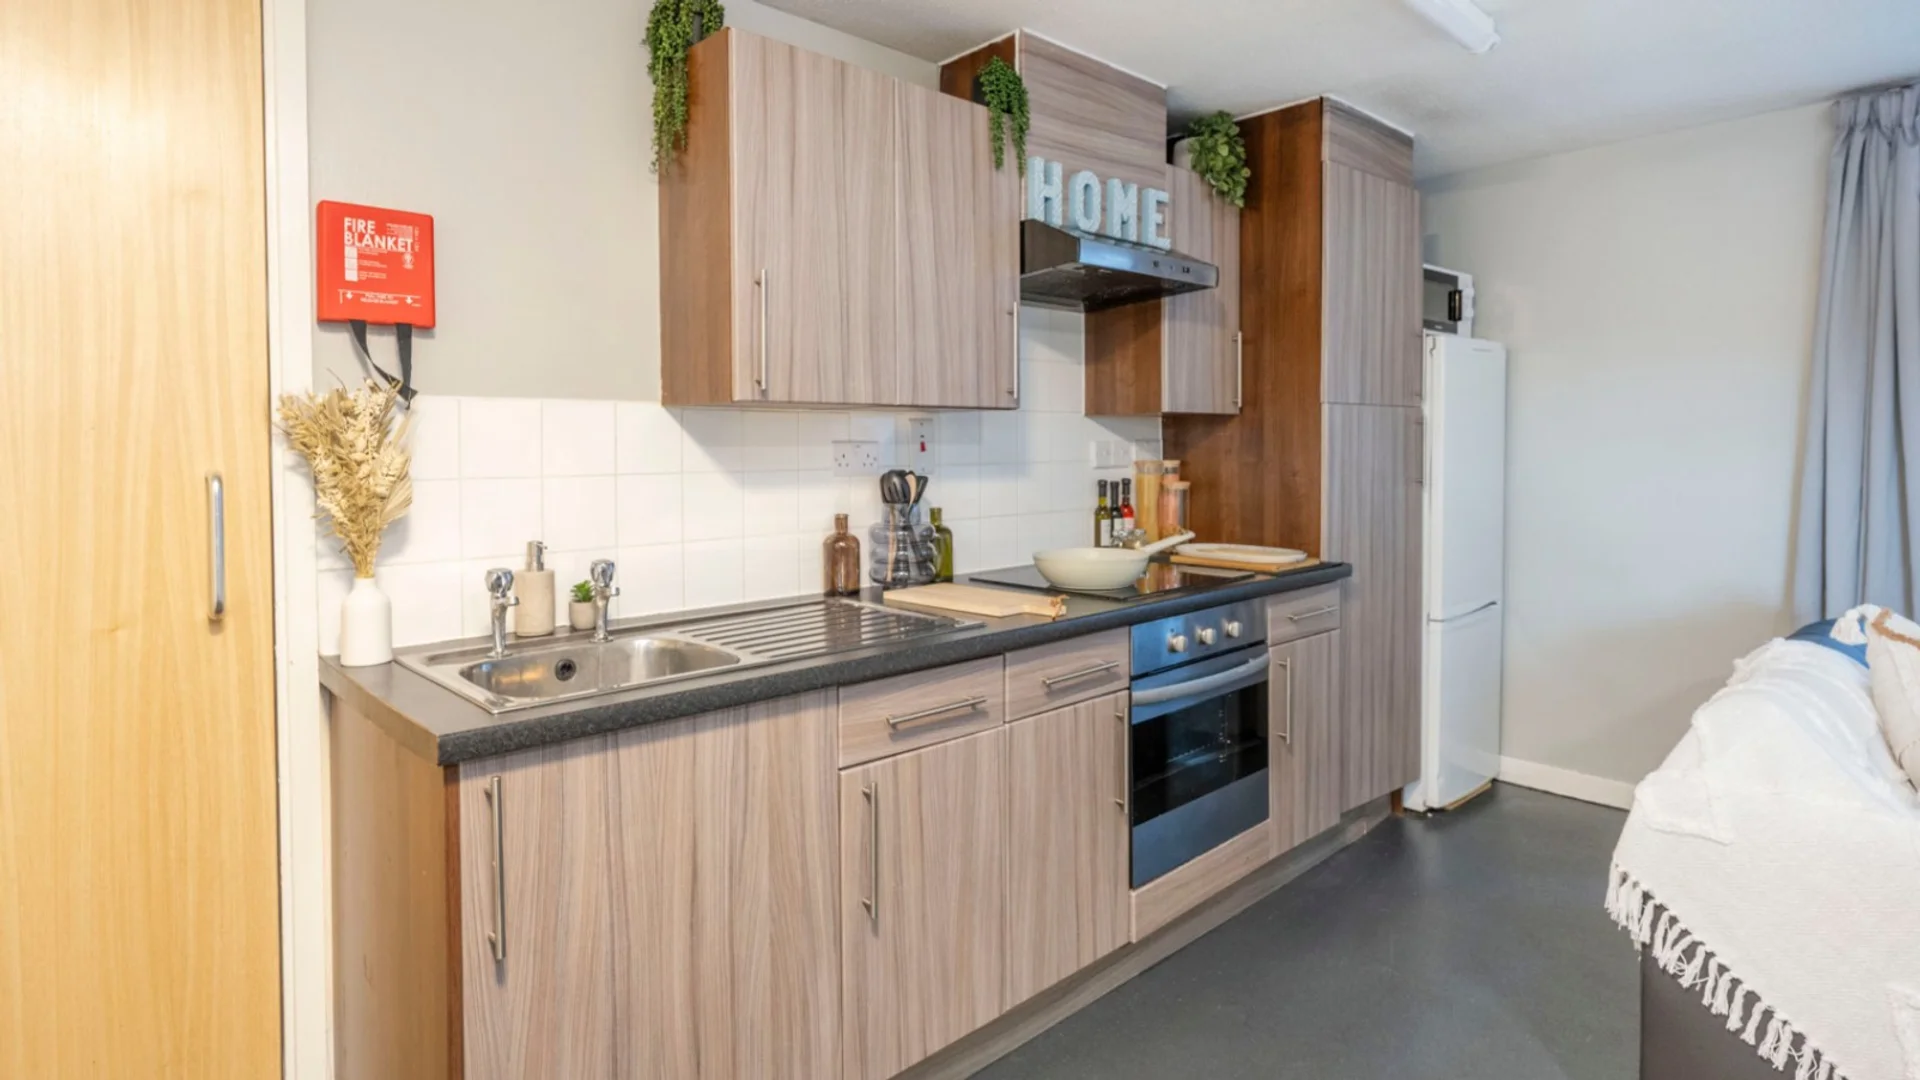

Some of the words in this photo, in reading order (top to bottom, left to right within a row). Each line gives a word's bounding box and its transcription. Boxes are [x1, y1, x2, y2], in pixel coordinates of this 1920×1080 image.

[1028, 156, 1171, 251] HOME
[344, 217, 375, 235] FIRE
[344, 231, 413, 253] BLANKET
